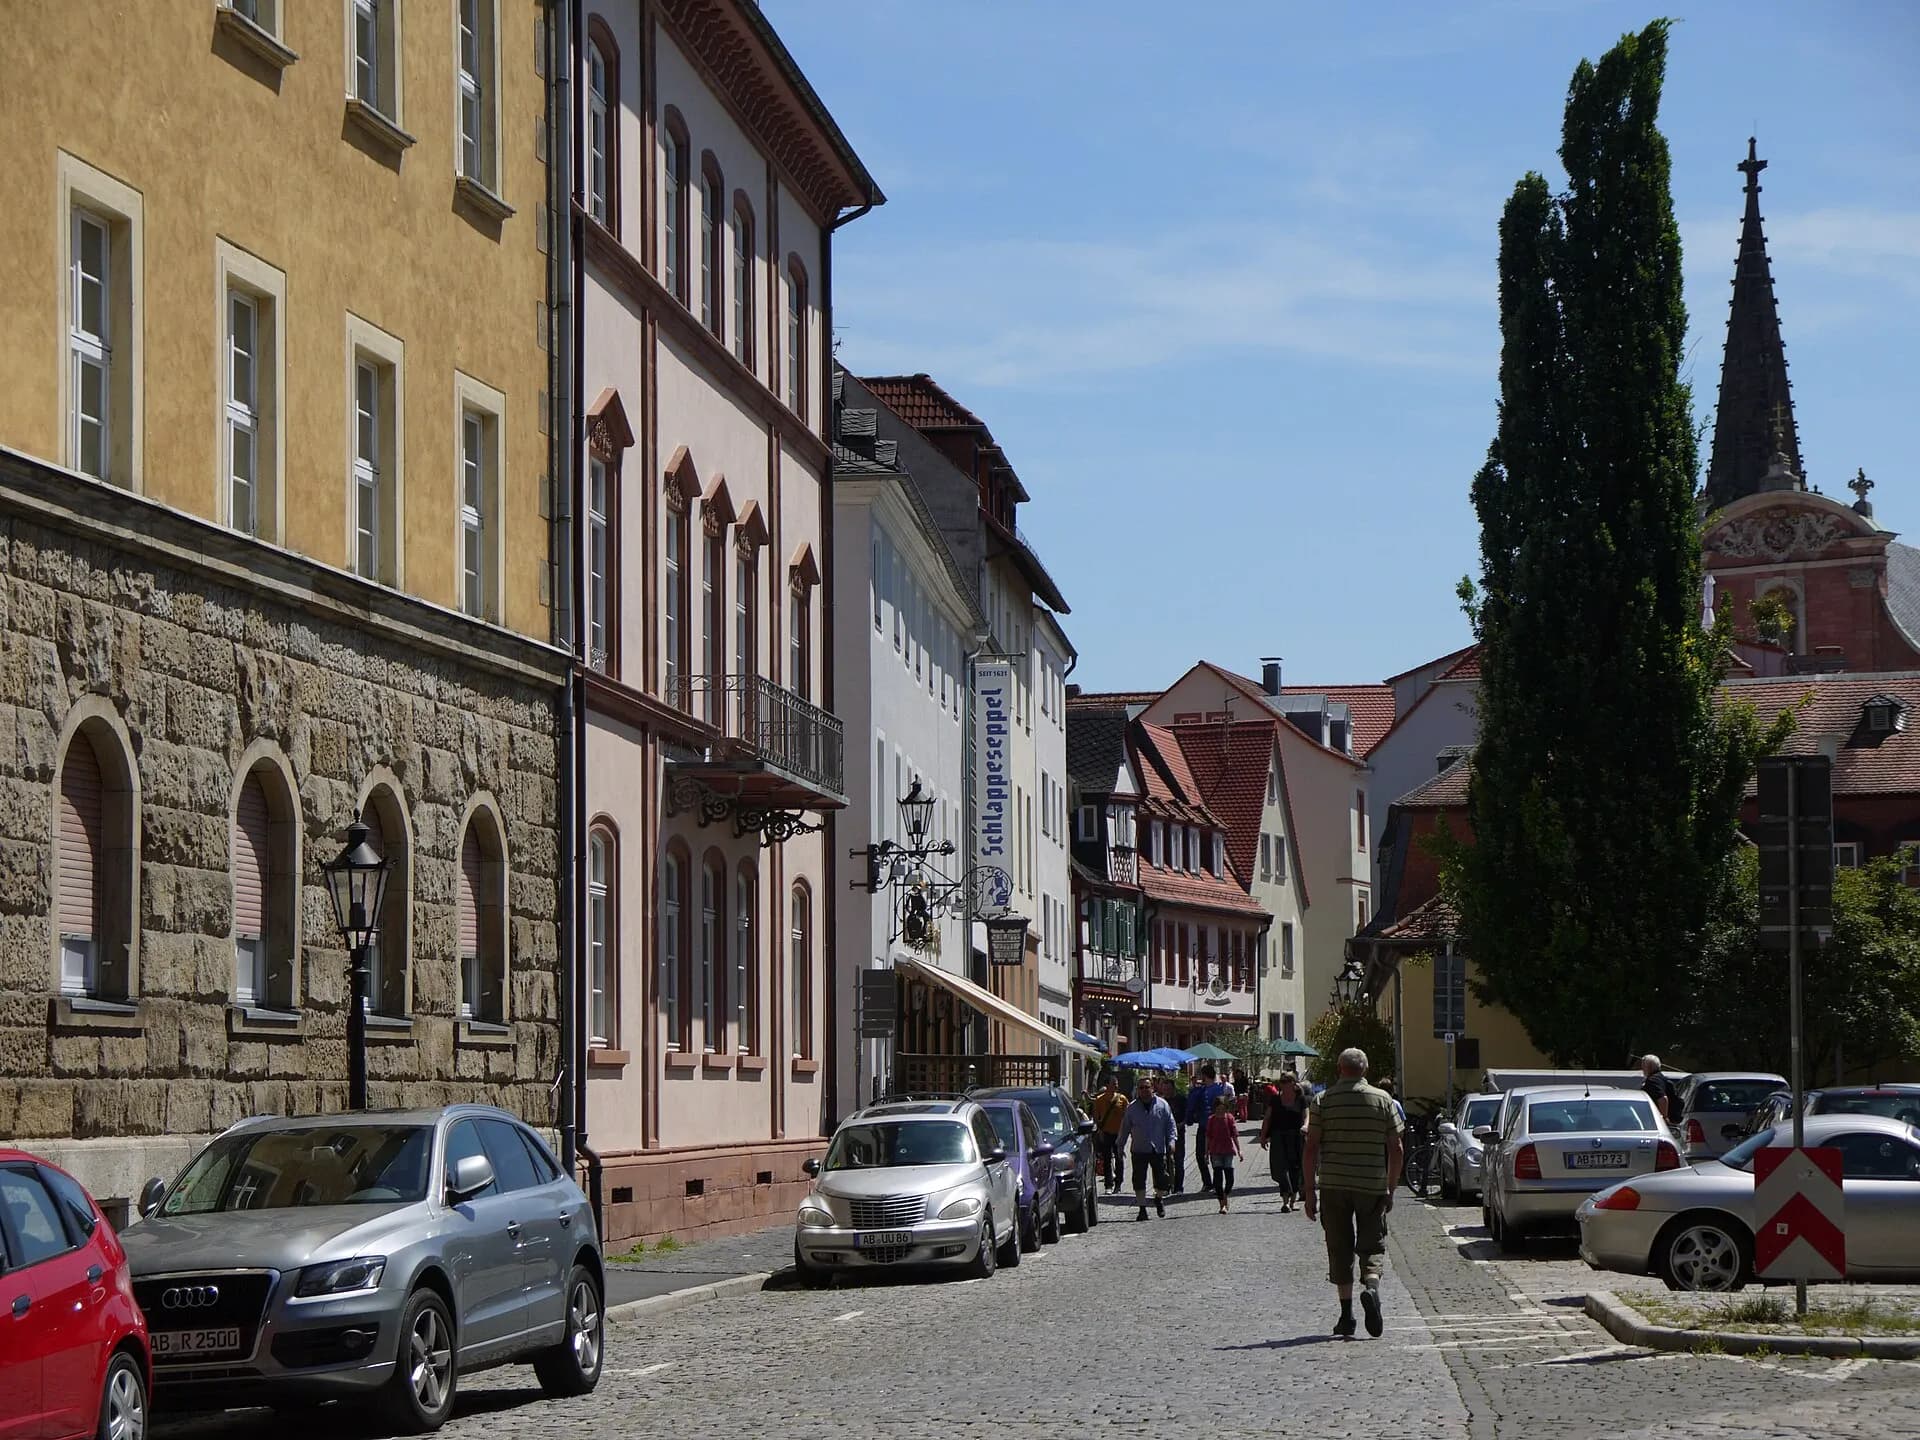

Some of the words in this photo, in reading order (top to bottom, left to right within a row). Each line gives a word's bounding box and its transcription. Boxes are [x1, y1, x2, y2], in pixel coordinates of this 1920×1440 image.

[981, 688, 1008, 856] Schlappeseppel
[1576, 1154, 1589, 1165] AB
[863, 1234, 875, 1244] AB
[896, 1232, 909, 1242] 86
[149, 1335, 170, 1352] AB
[181, 1333, 192, 1350] R
[196, 1330, 238, 1349] 2500
